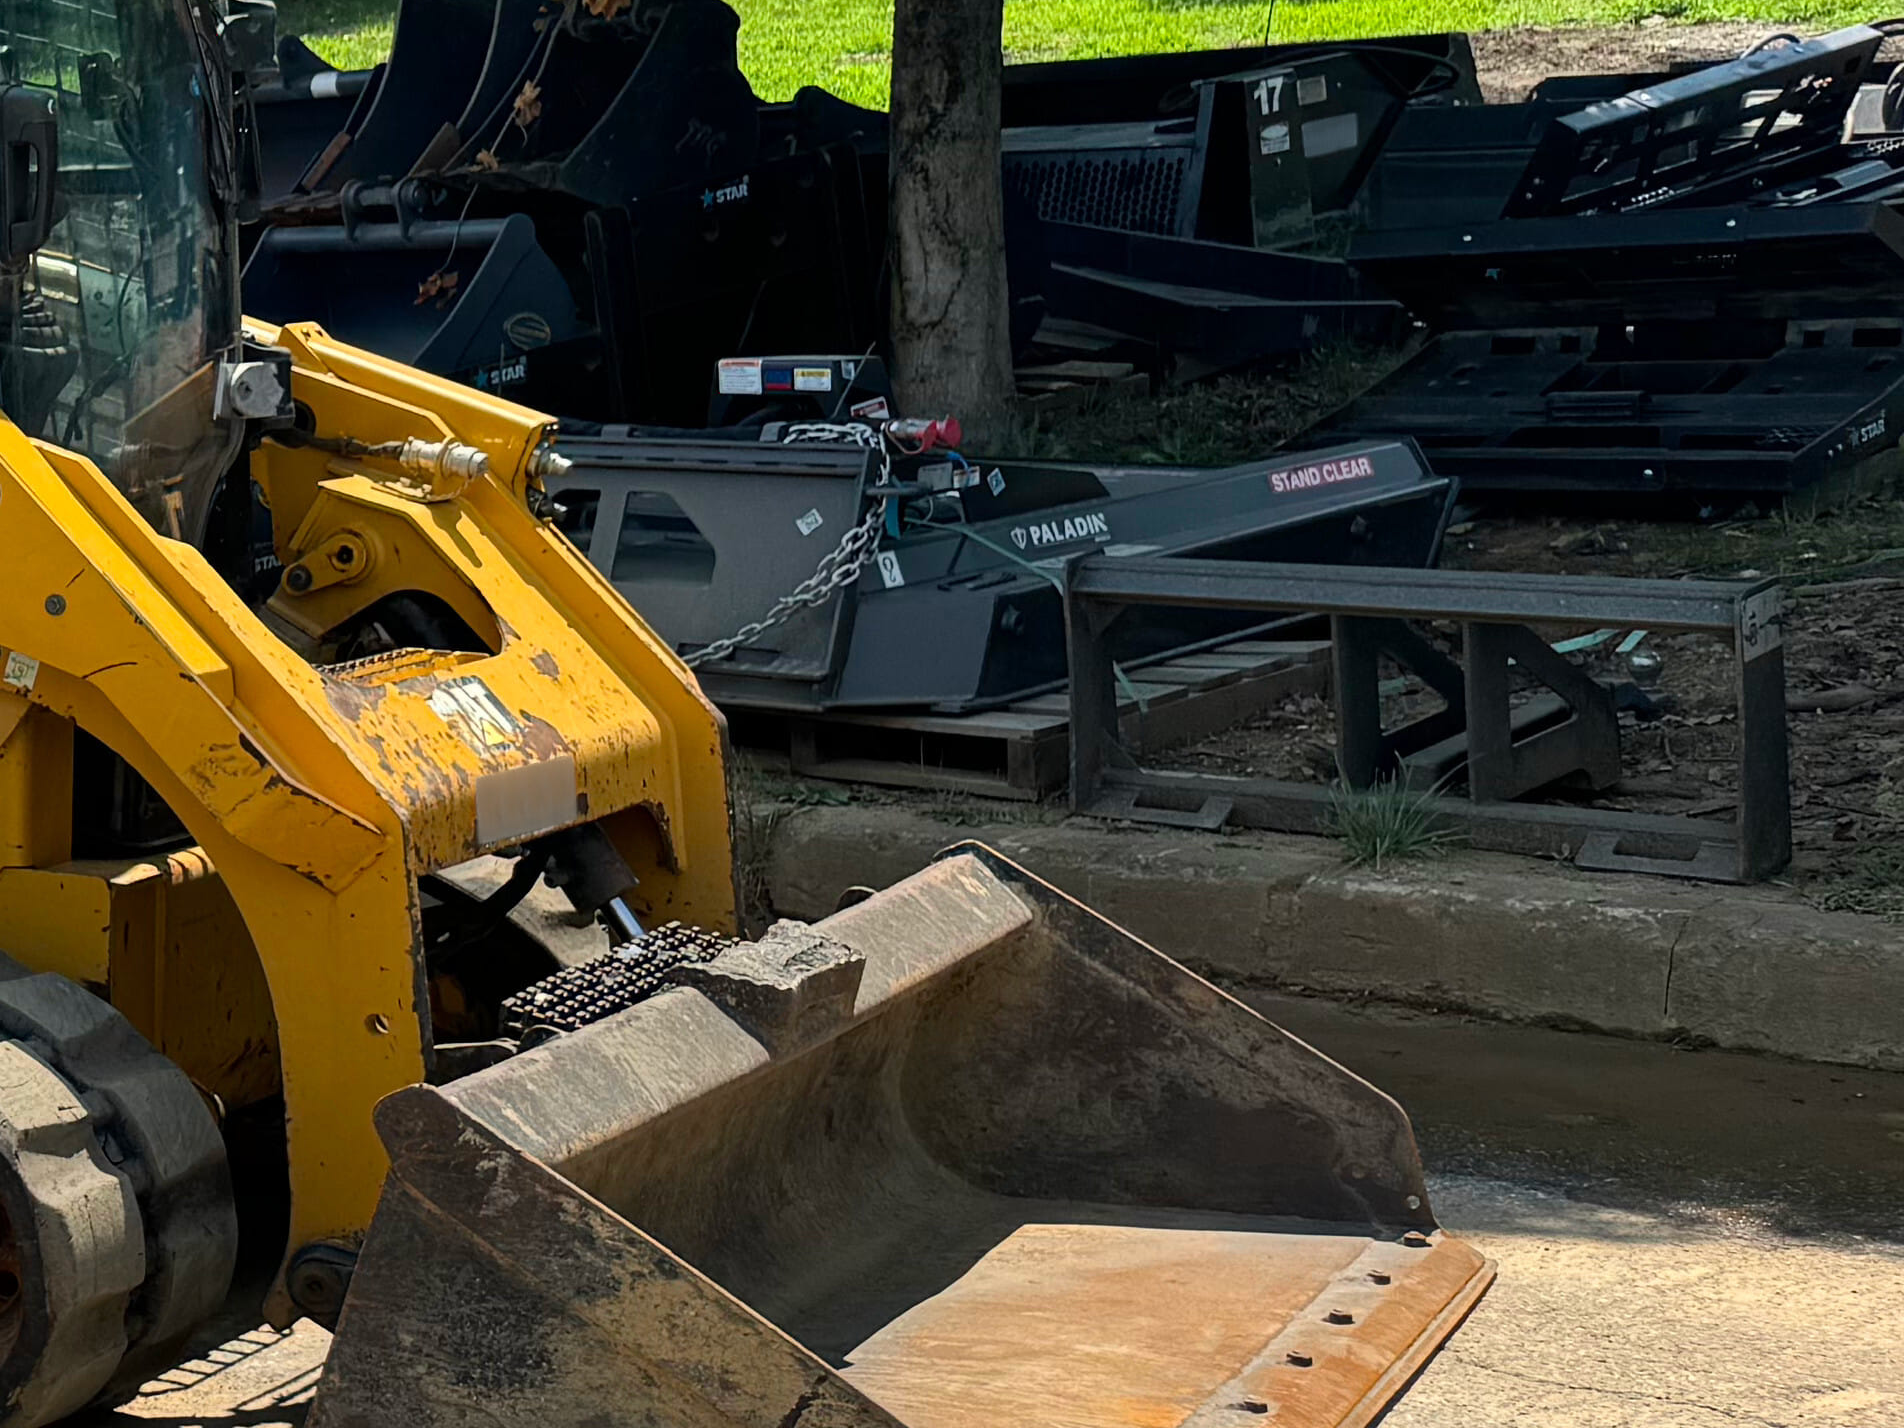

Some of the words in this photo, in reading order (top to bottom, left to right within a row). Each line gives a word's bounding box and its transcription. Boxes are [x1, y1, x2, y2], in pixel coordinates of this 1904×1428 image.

[1254, 76, 1284, 116] 17
[716, 183, 748, 203] STAR
[1272, 467, 1321, 492] STAND
[1322, 457, 1371, 483] CLEAR
[1029, 513, 1108, 546] PALADIN
[255, 554, 281, 573] STA
